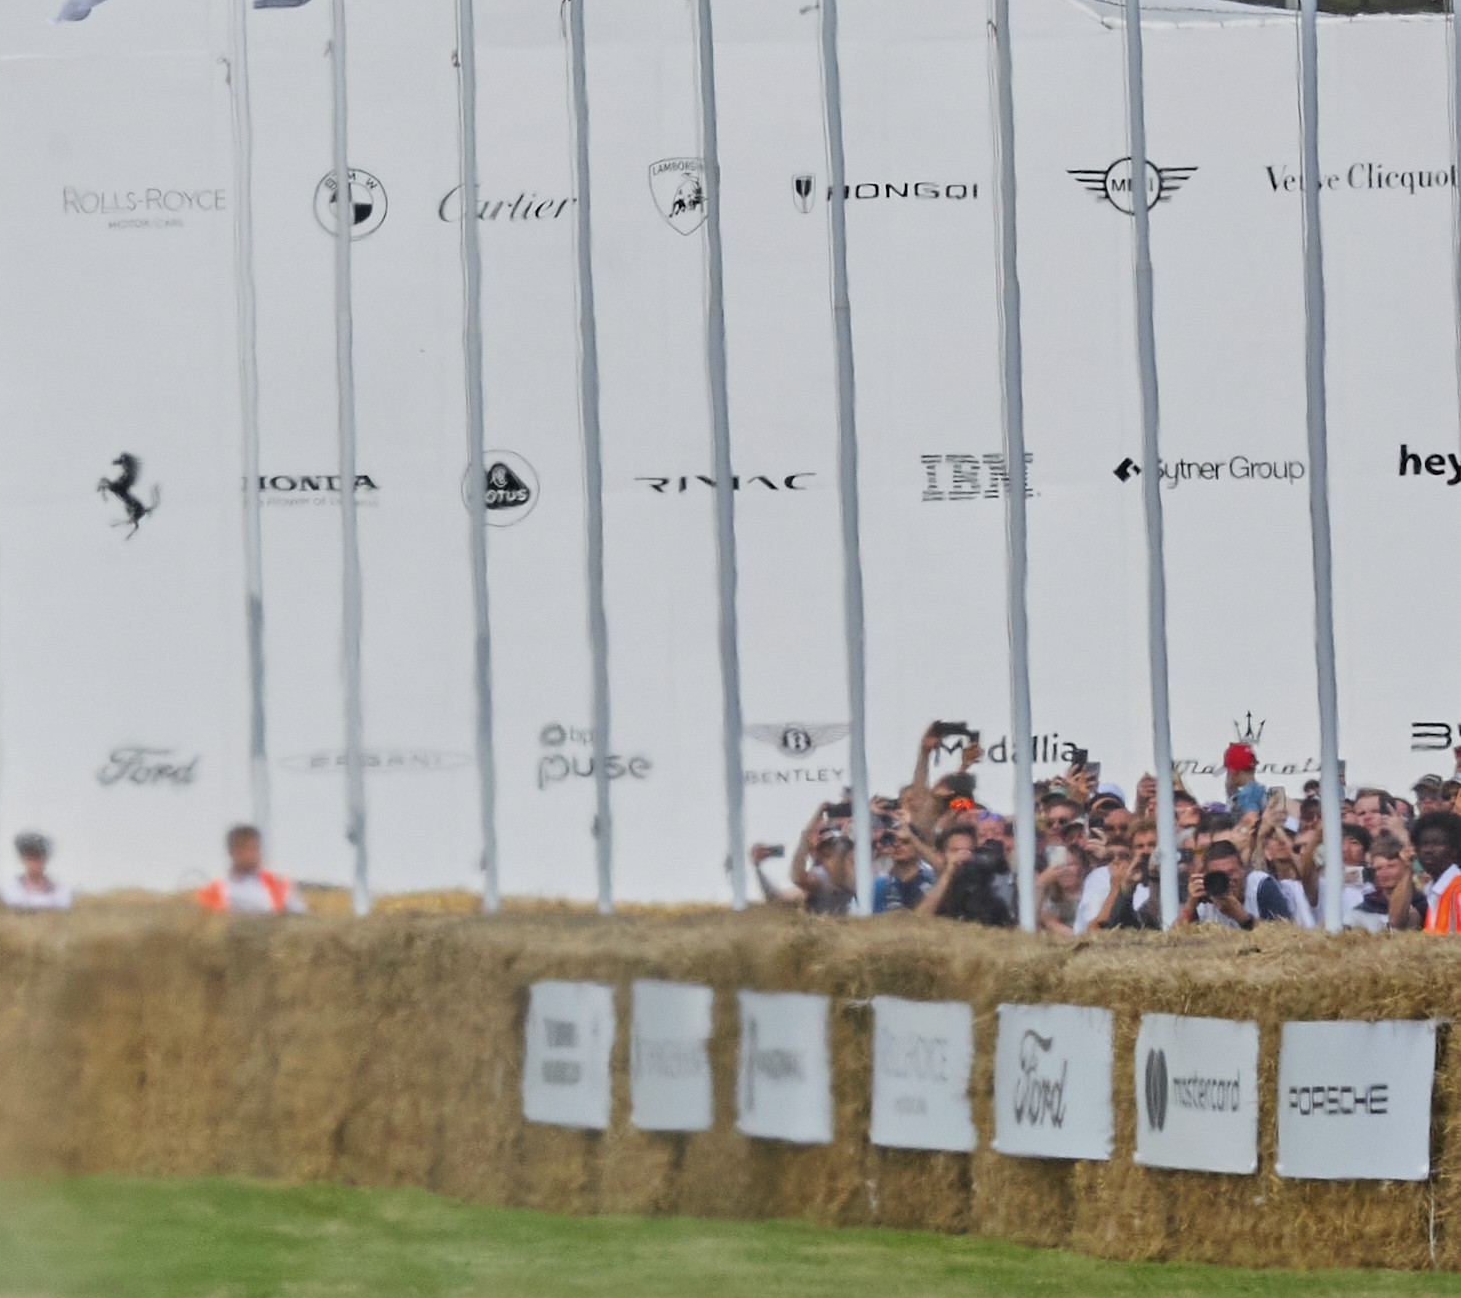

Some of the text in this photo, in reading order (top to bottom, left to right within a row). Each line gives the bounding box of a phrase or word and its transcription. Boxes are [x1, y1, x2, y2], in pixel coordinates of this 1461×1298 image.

[652, 161, 707, 176] LAMBORG
[1267, 164, 1340, 193] Vee
[1112, 178, 1154, 193] MII
[63, 186, 226, 214] ROLLS-ROYCE
[921, 454, 1034, 501] IBM
[1229, 455, 1306, 484] Group
[1399, 444, 1461, 486] hey
[484, 488, 527, 503] OTUS
[538, 751, 653, 791] puse
[745, 768, 844, 785] BENTLEY
